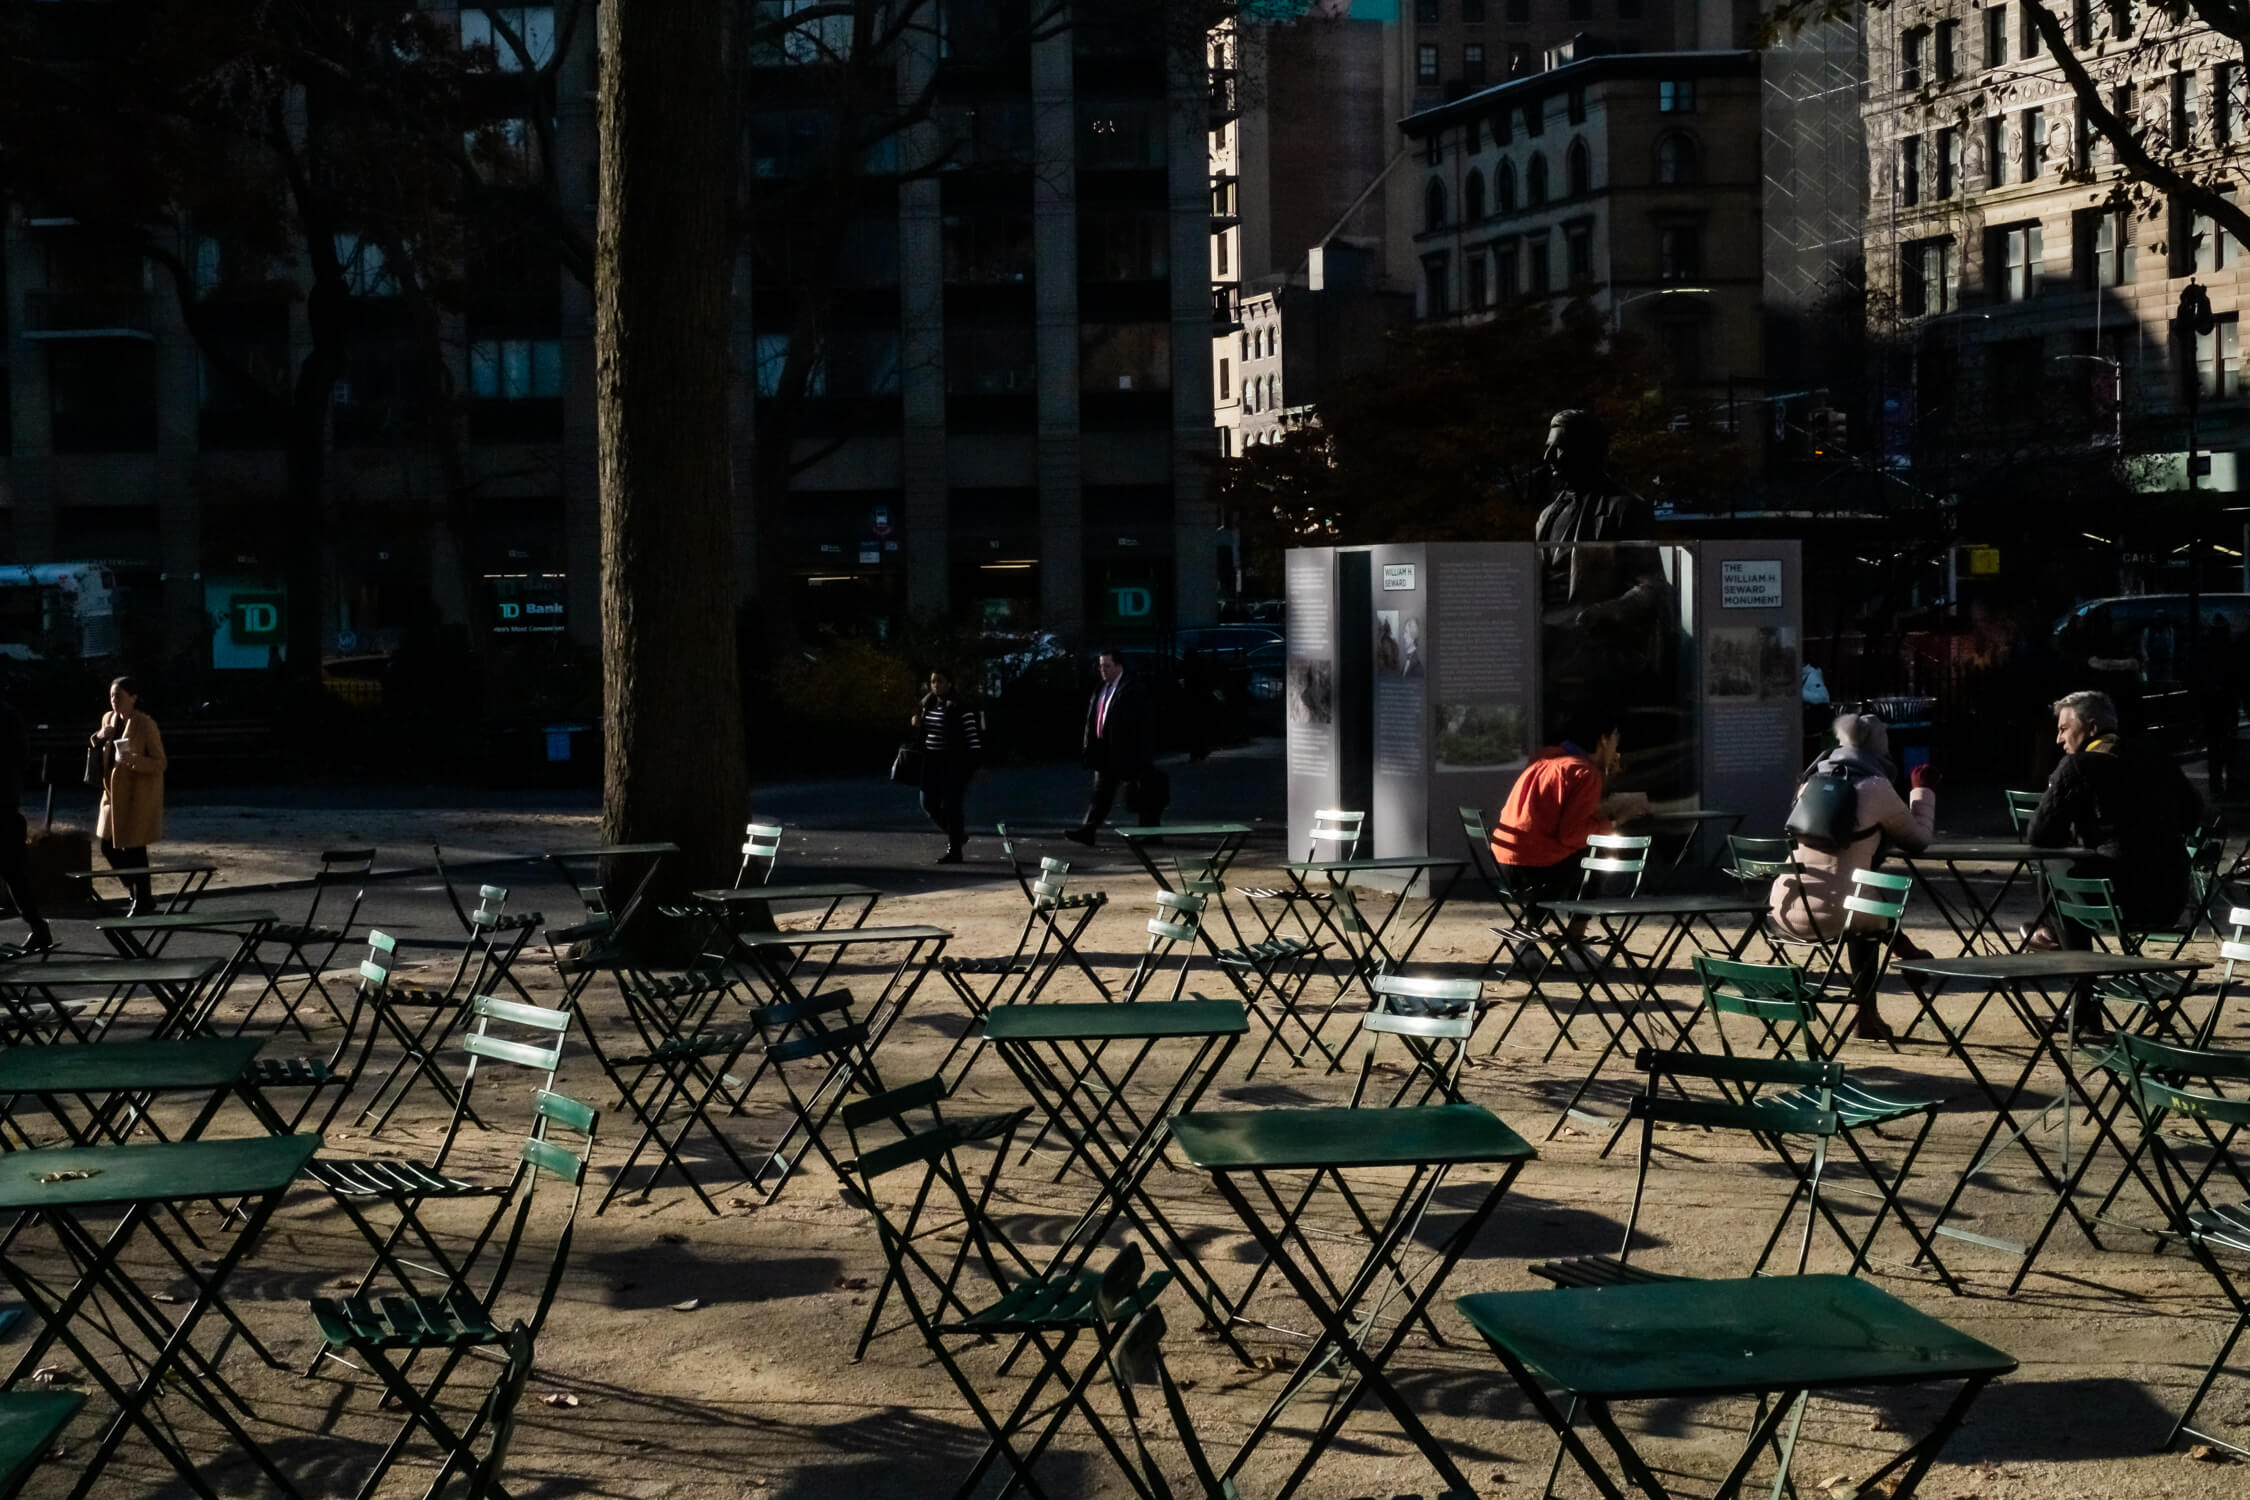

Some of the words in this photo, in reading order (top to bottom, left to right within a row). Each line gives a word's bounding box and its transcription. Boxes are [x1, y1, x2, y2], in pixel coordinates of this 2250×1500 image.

[1385, 568, 1406, 576] WILLIAM
[1724, 564, 1743, 572] THE
[1385, 579, 1406, 587] SEWARD
[1724, 574, 1766, 583] WILLIAM
[1724, 585, 1766, 594] SEWARD
[1112, 587, 1152, 616] TD
[1724, 596, 1780, 605] MONUMENT
[499, 603, 520, 618] TD
[526, 602, 565, 614] Bank
[237, 603, 277, 632] TD
